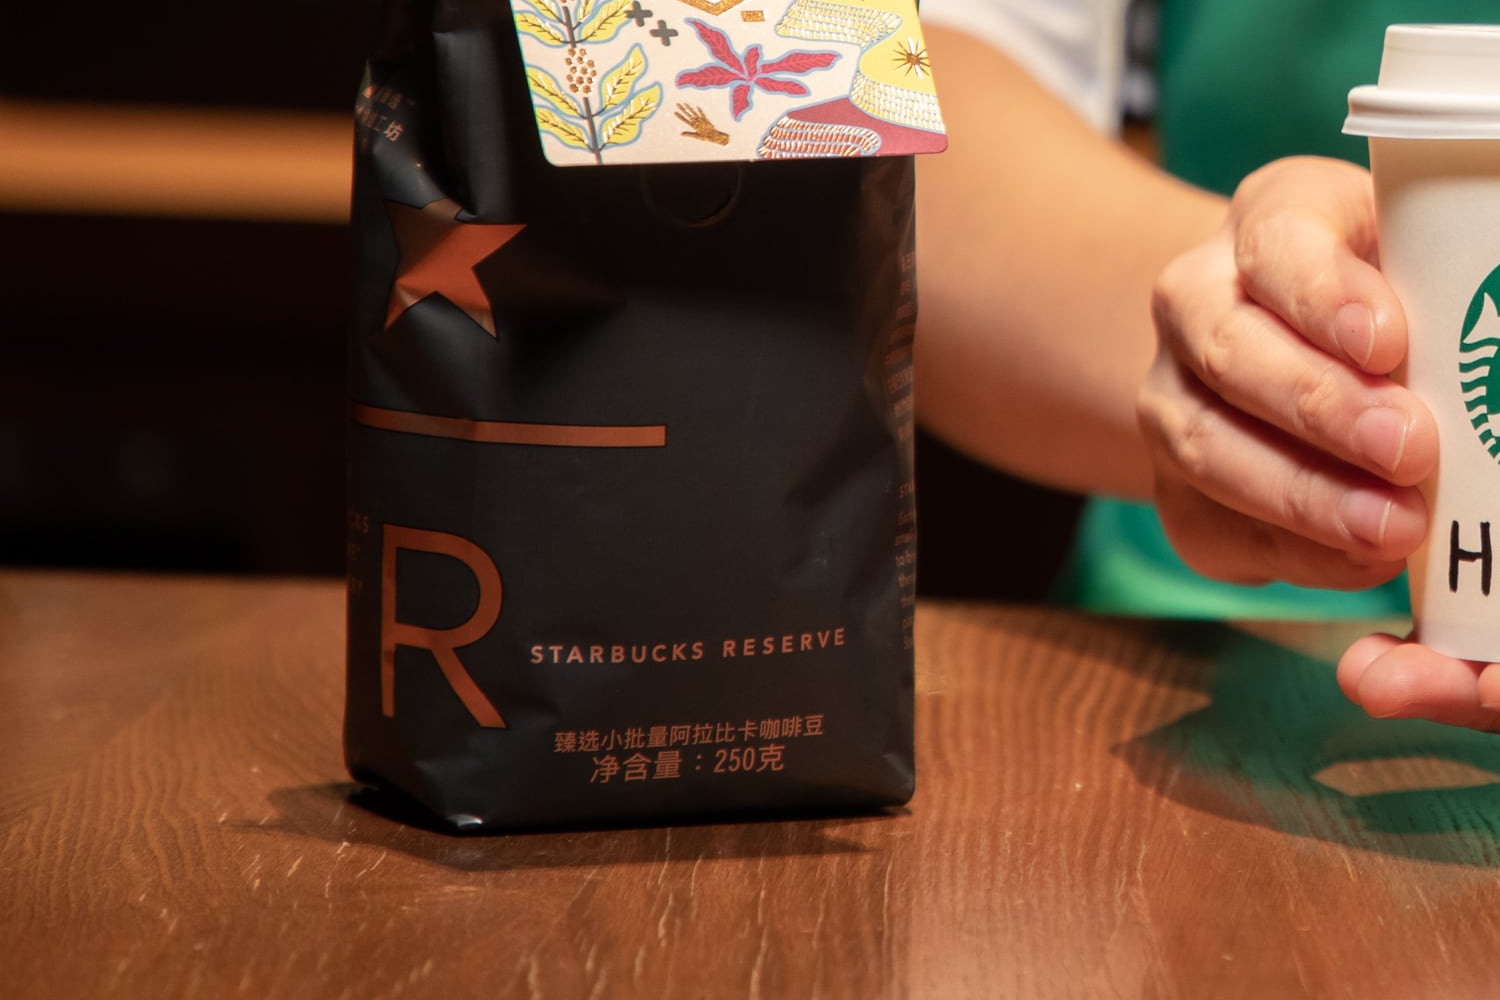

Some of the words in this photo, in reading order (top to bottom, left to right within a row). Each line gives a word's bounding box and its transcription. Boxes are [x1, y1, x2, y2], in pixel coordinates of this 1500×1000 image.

[381, 522, 507, 729] R
[529, 640, 705, 665] STARBUCKS
[721, 626, 847, 660] RESERVE
[553, 713, 825, 754] 臻选小批量阿拉比卡咖啡豆
